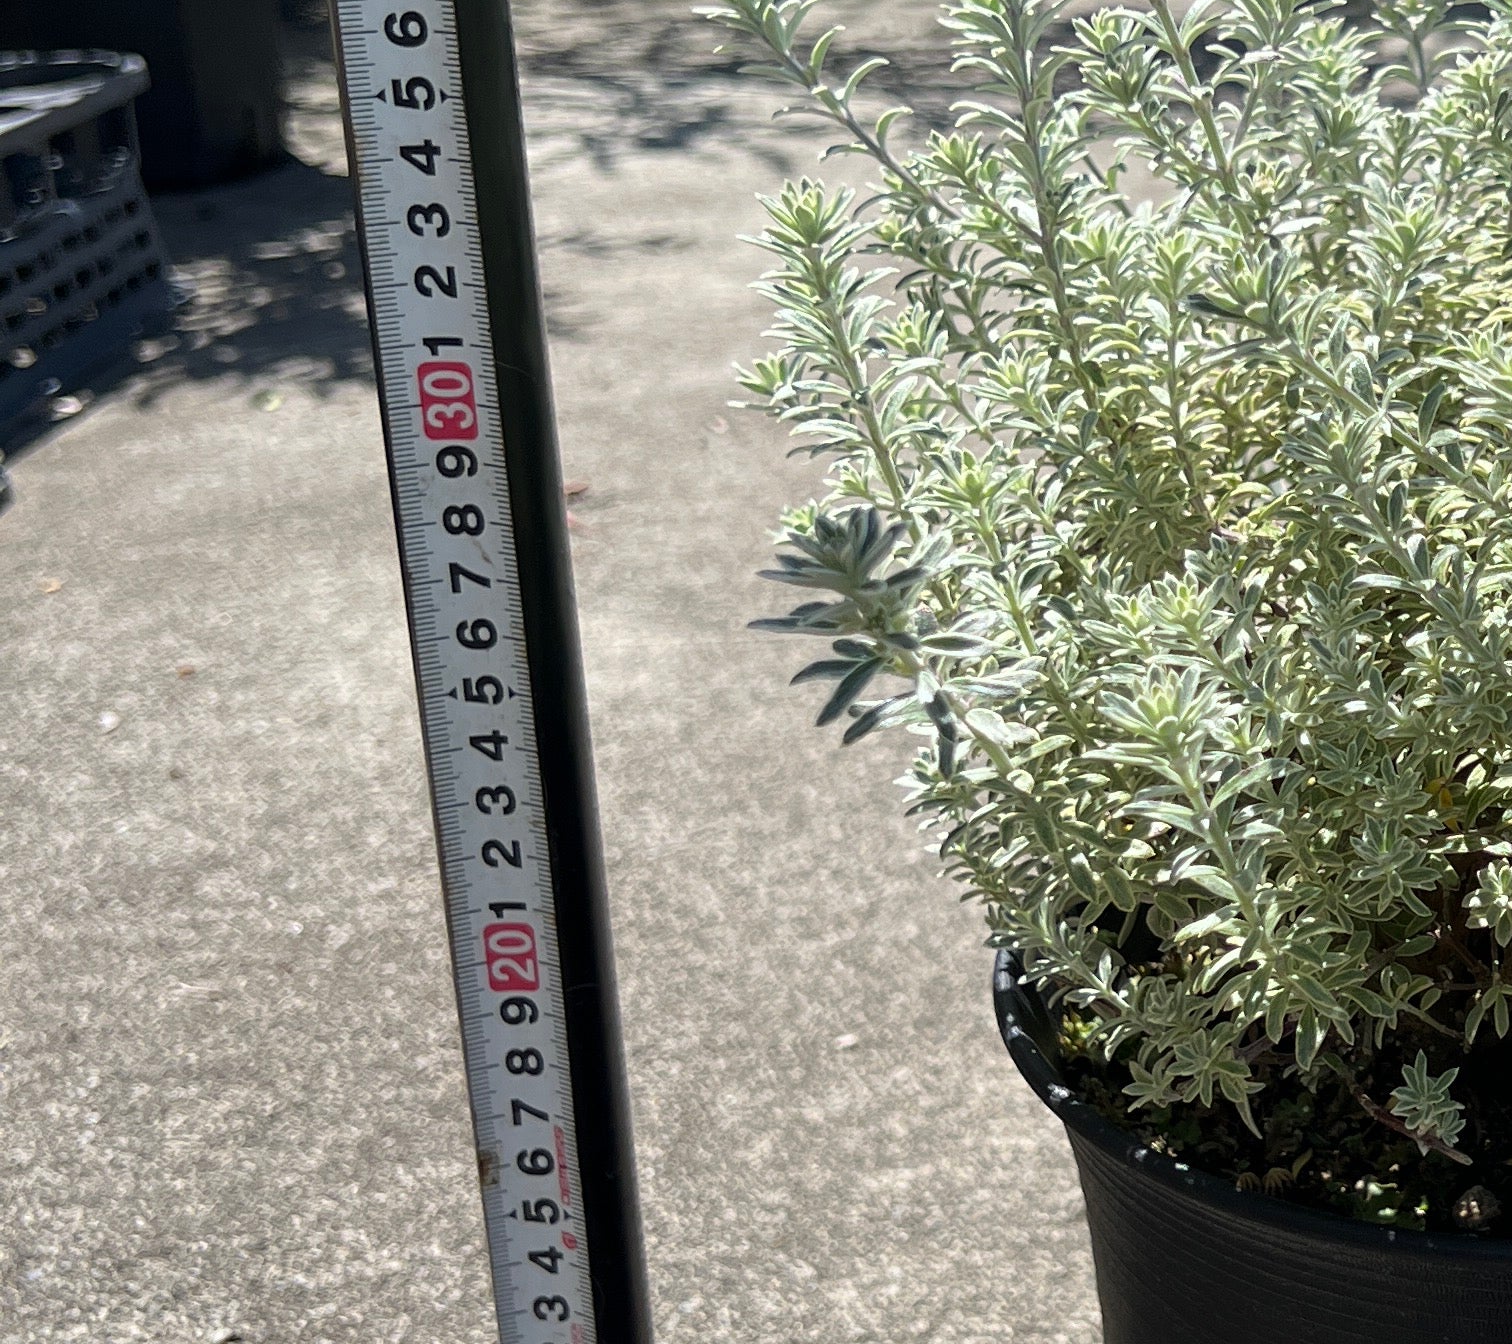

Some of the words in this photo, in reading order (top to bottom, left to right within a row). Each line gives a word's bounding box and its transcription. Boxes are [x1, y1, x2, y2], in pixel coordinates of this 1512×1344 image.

[384, 11, 427, 47] 6
[392, 77, 435, 111] 5
[400, 139, 441, 176] 4
[407, 203, 450, 237] 3
[414, 266, 457, 298] 2
[423, 337, 463, 356] 1
[423, 370, 474, 429] 30
[436, 446, 478, 478] 9
[443, 504, 484, 536] 8
[449, 563, 491, 593] 7
[456, 619, 497, 650] 6
[462, 676, 503, 704] 5
[469, 730, 508, 761] 4
[476, 786, 516, 815] 3
[482, 840, 522, 868] 2
[489, 902, 526, 918] 1
[489, 929, 536, 983] 20
[500, 997, 538, 1025] 9
[505, 1048, 544, 1076] 8
[511, 1099, 549, 1126] 7
[517, 1149, 554, 1175] 6
[522, 1199, 559, 1224] 5
[528, 1246, 563, 1274] 4
[533, 1296, 569, 1322] 3
